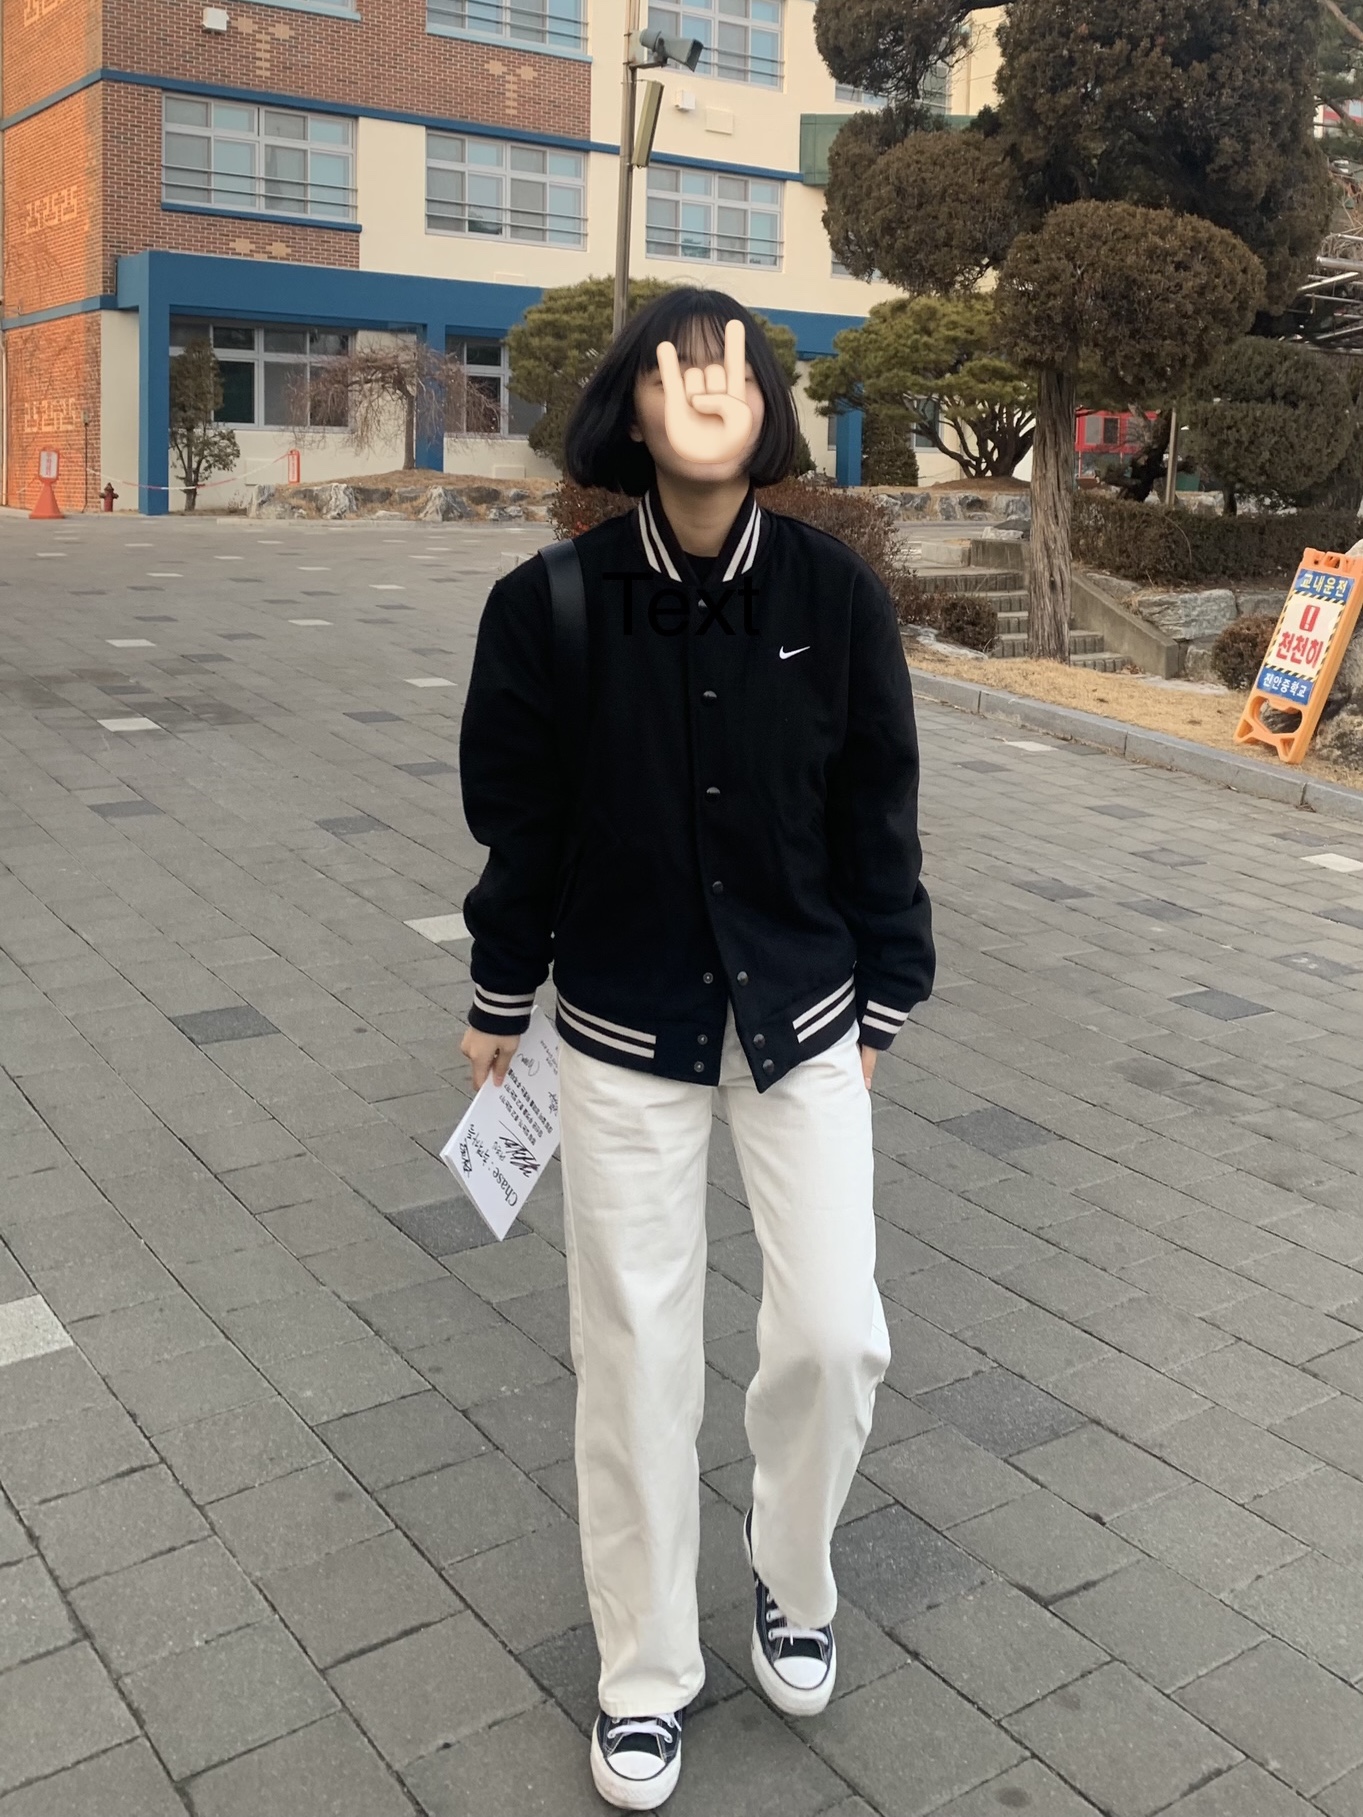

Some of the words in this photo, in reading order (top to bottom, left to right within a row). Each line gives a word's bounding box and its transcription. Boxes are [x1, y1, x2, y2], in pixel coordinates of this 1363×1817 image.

[1300, 573, 1348, 597] 교내운전
[1276, 631, 1324, 669] 천천히
[1263, 673, 1307, 697] 진안중학교
[492, 1167, 518, 1206] Chase
